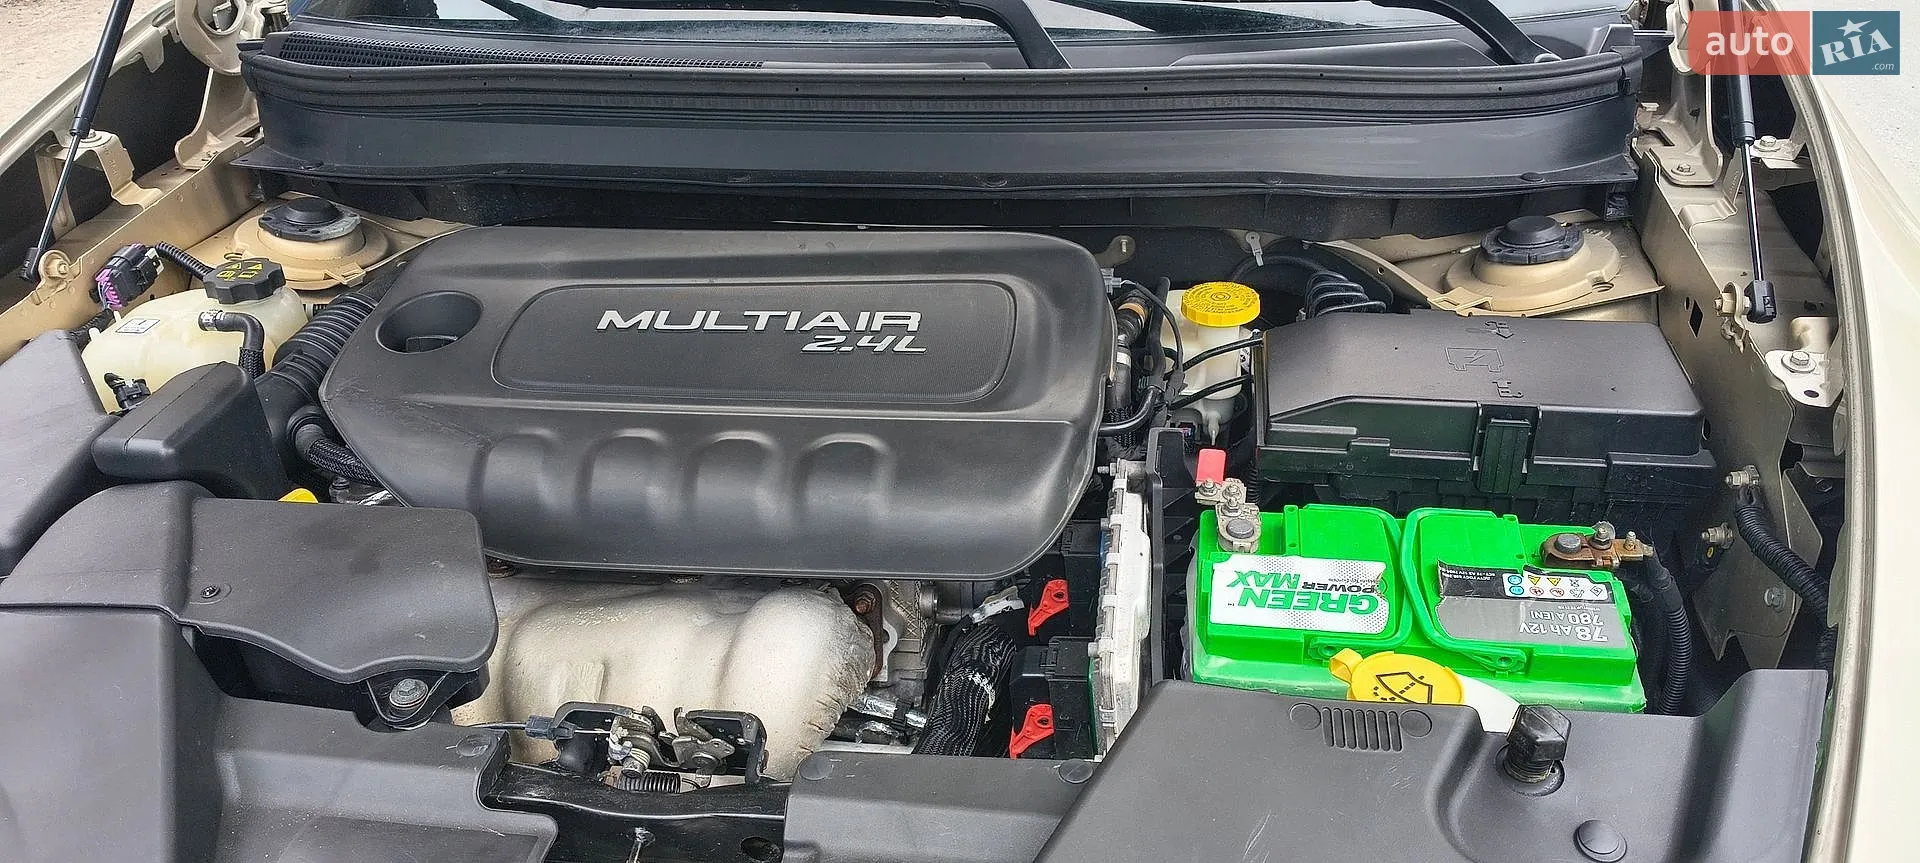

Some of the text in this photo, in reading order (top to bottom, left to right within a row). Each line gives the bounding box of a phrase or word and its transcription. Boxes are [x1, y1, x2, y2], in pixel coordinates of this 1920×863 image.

[596, 310, 923, 332] MULTIAIR
[801, 335, 927, 353] 2.4L
[1227, 570, 1301, 589] MAX
[1301, 581, 1375, 594] POWER
[1238, 588, 1379, 615] GREEN
[1568, 612, 1604, 626] 780
[1519, 622, 1608, 642] 78 Ah 12V
